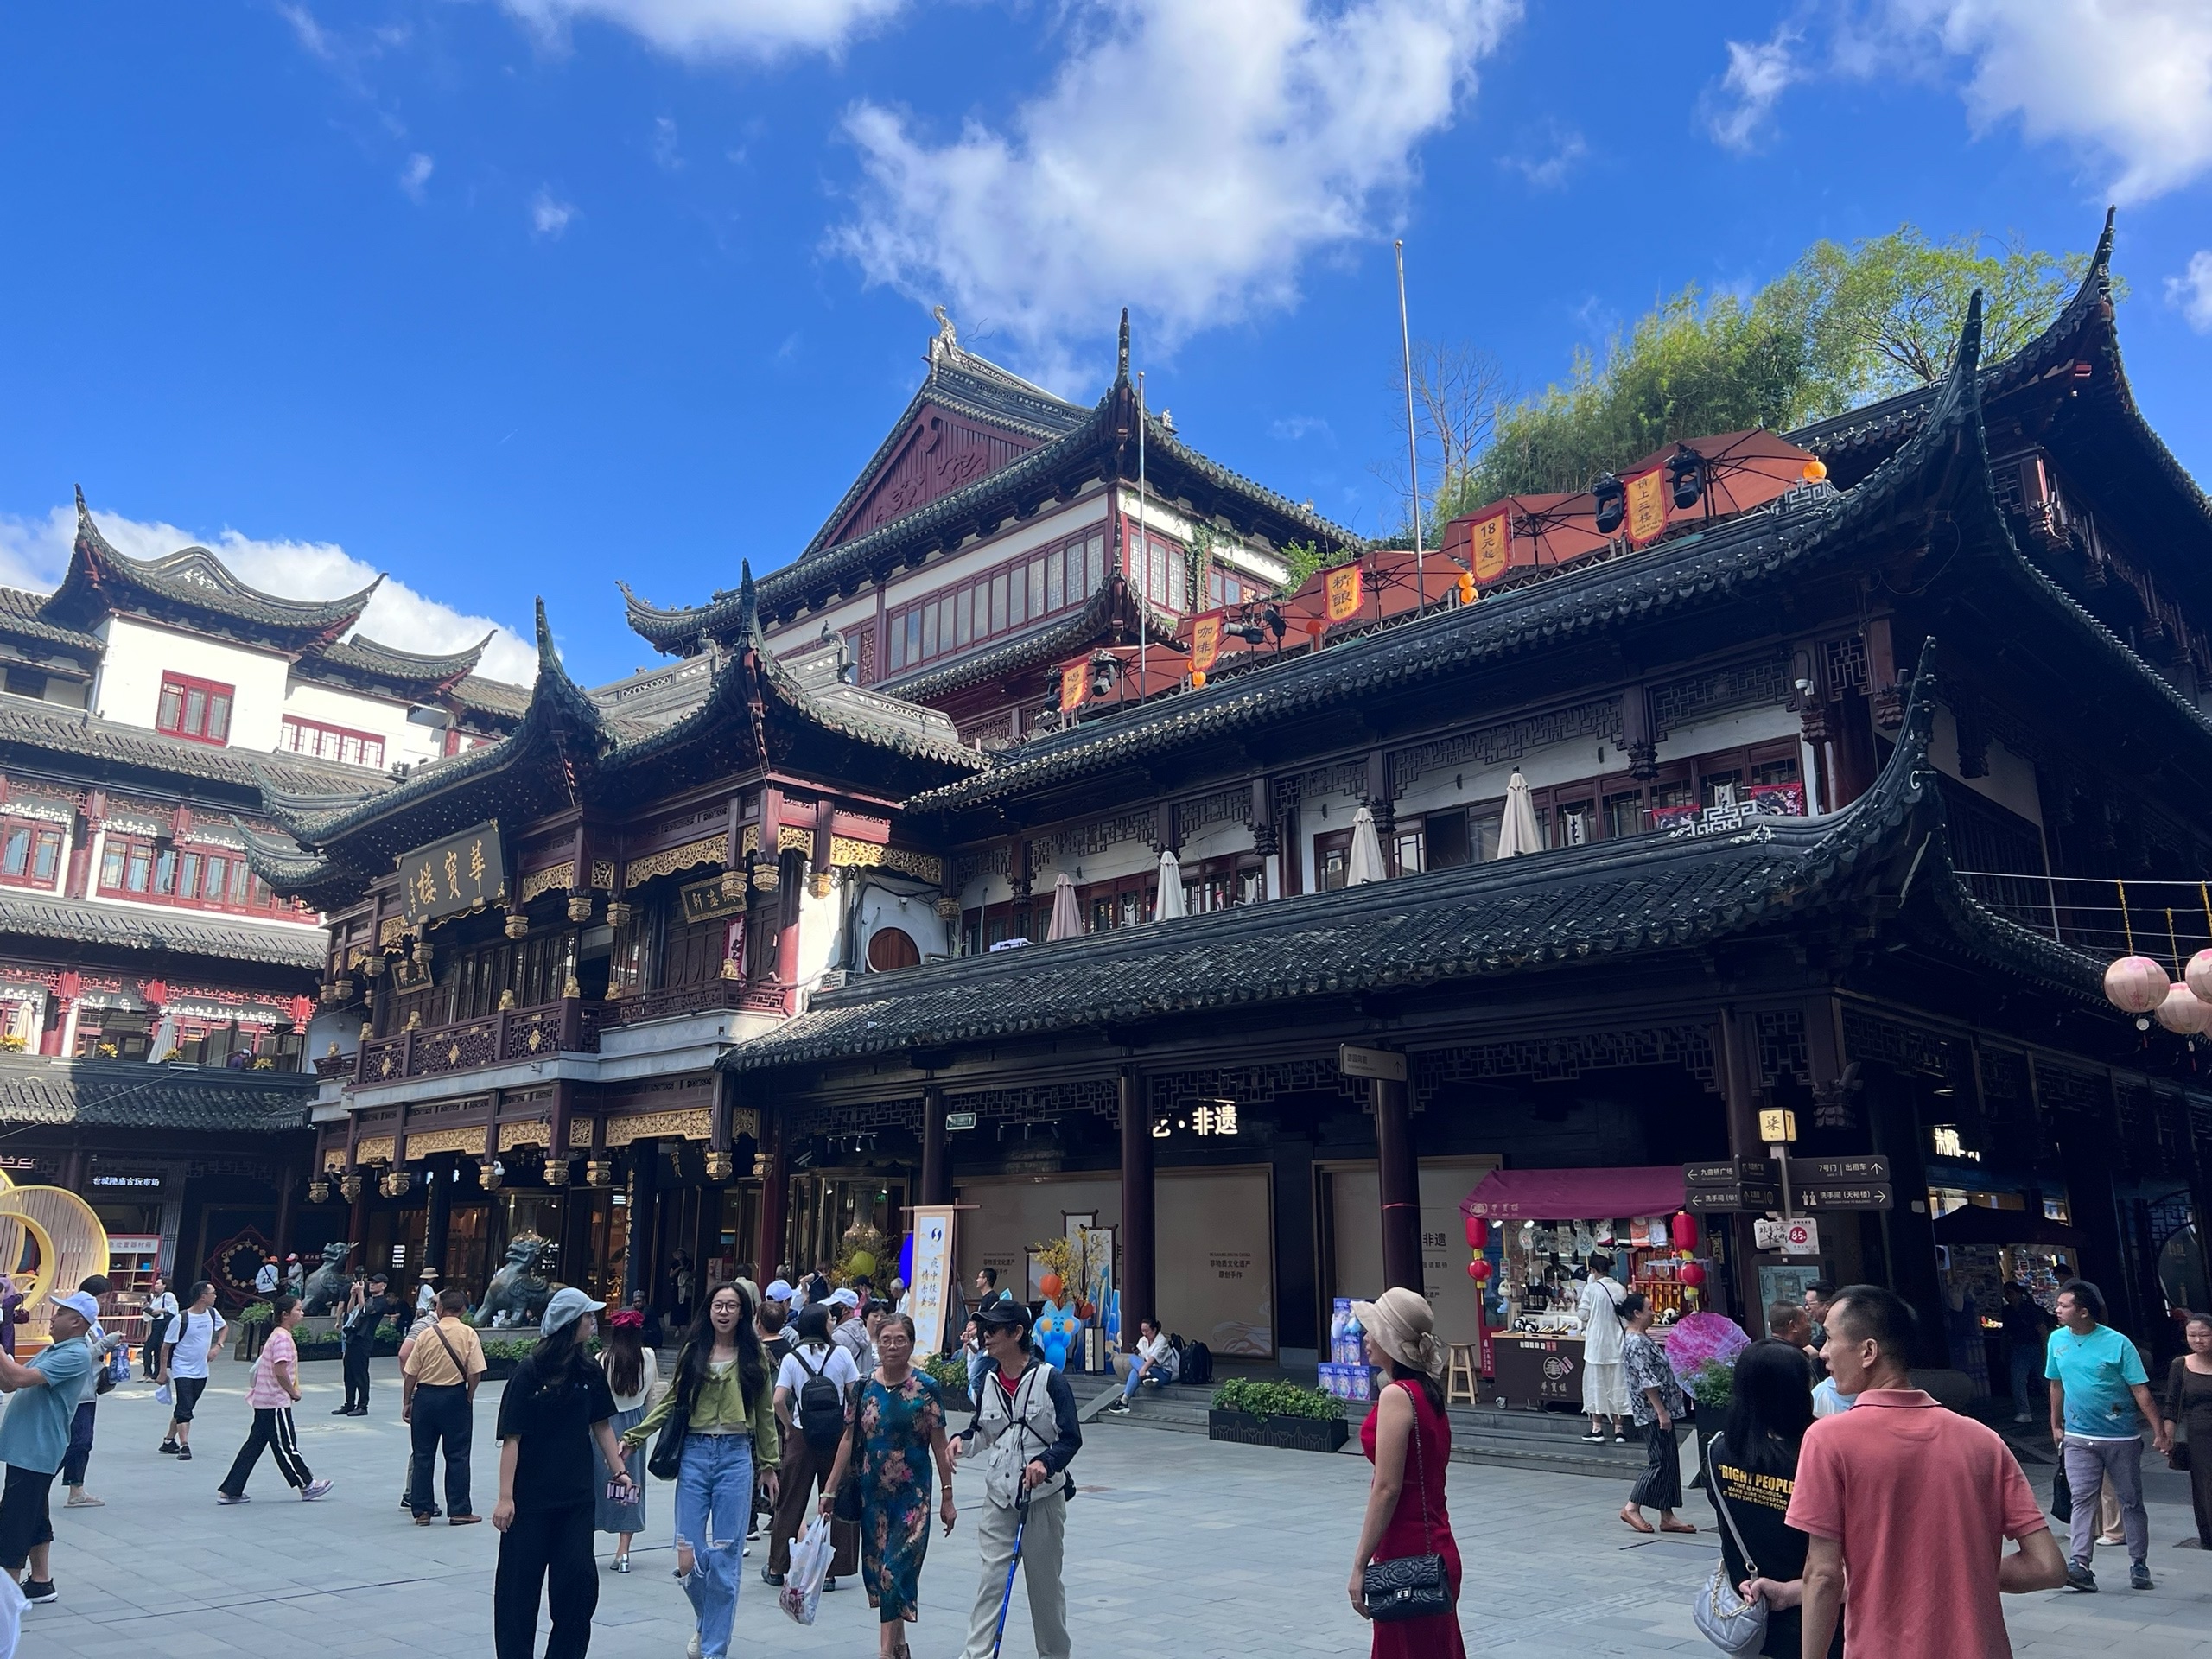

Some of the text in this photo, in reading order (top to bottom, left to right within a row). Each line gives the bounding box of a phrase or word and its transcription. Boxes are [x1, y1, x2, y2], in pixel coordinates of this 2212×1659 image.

[1637, 478, 1652, 524] 请上三楼
[1332, 574, 1353, 607] 精酿
[1197, 625, 1212, 653] 咖啡
[1765, 1116, 1780, 1131] 柒
[1786, 1115, 1791, 1131] 7
[1700, 1167, 1733, 1176] 九曲桥广场
[1845, 1163, 1866, 1172] 出租车
[92, 1176, 160, 1186] 老城隍庙古玩市场
[1422, 1232, 1447, 1246] 非遗
[1728, 1486, 1742, 1495] MAKE
